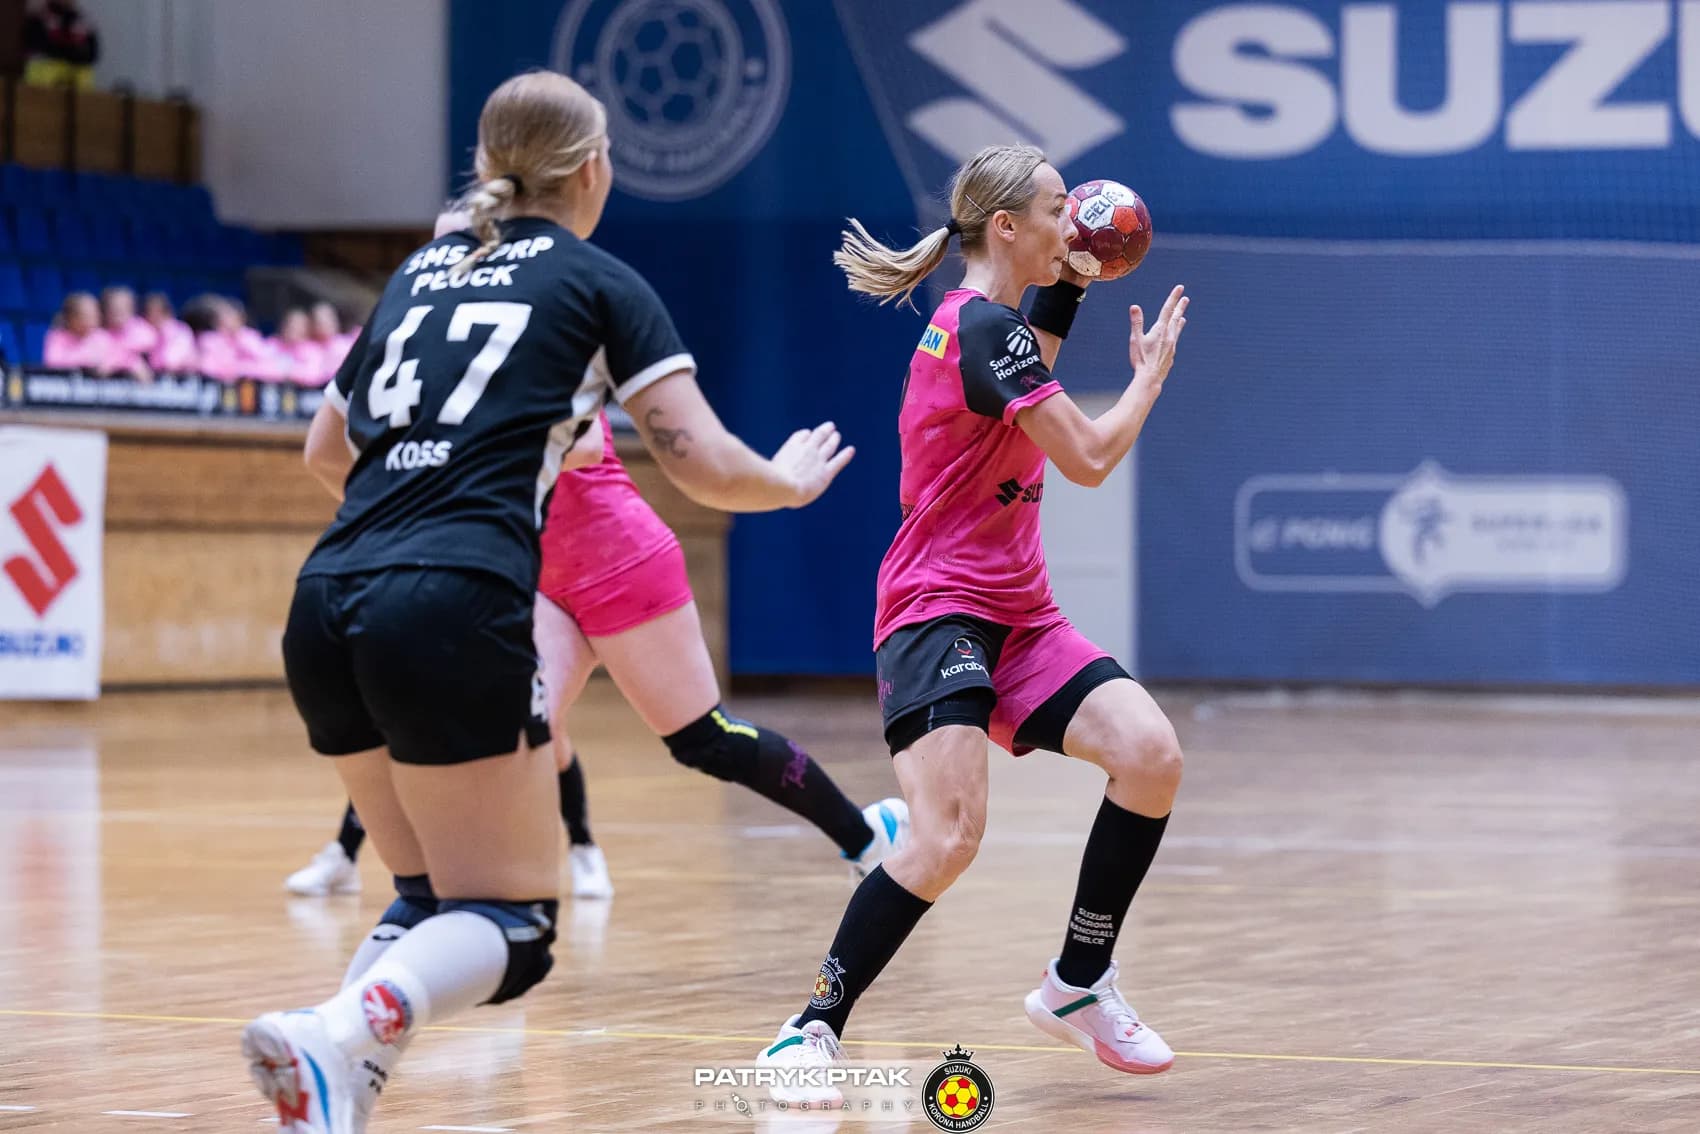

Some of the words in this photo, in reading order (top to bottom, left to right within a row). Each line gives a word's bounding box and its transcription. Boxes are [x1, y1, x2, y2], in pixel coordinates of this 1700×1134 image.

[1169, 3, 1700, 160] SUZ
[404, 245, 469, 275] SMS
[477, 236, 555, 262] PRP
[368, 301, 533, 429] 47
[989, 355, 1012, 371] Sun
[385, 440, 453, 471] KOSS
[1074, 914, 1113, 929] KORONA
[1078, 907, 1113, 921] SUZUKI
[1073, 933, 1105, 945] KIELCE
